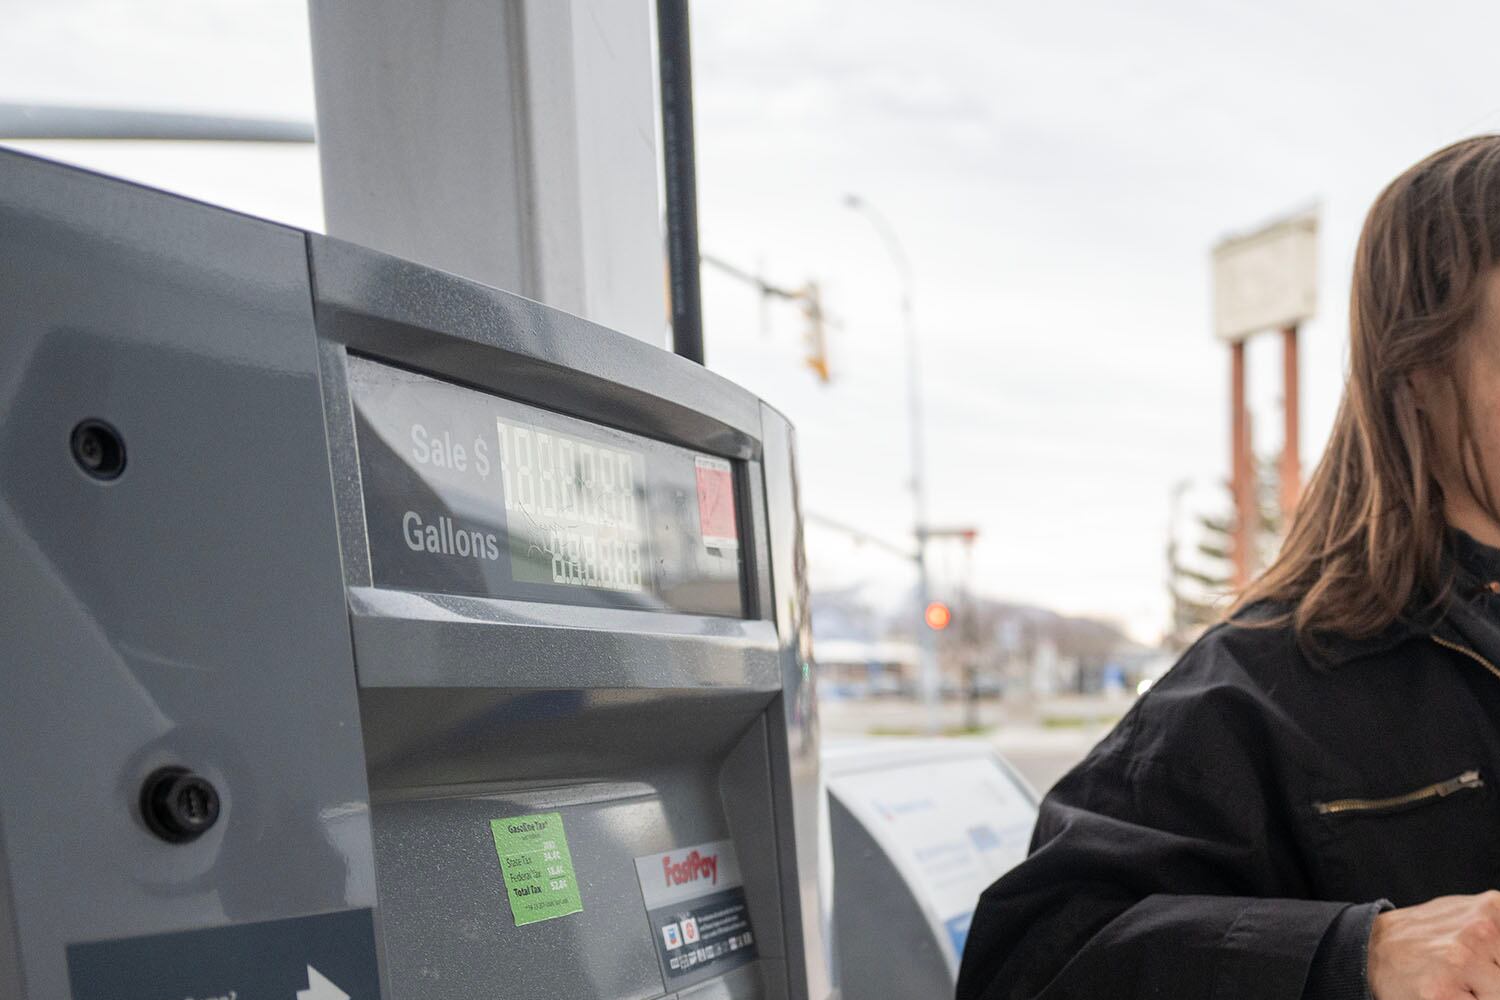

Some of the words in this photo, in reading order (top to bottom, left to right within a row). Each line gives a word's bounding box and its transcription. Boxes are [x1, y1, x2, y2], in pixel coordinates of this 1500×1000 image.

[411, 423, 467, 471] Sale
[474, 434, 491, 481] $
[402, 511, 500, 561] Gallons
[513, 886, 530, 897] Total
[531, 884, 542, 894] Tax
[662, 850, 719, 888] FastPay
